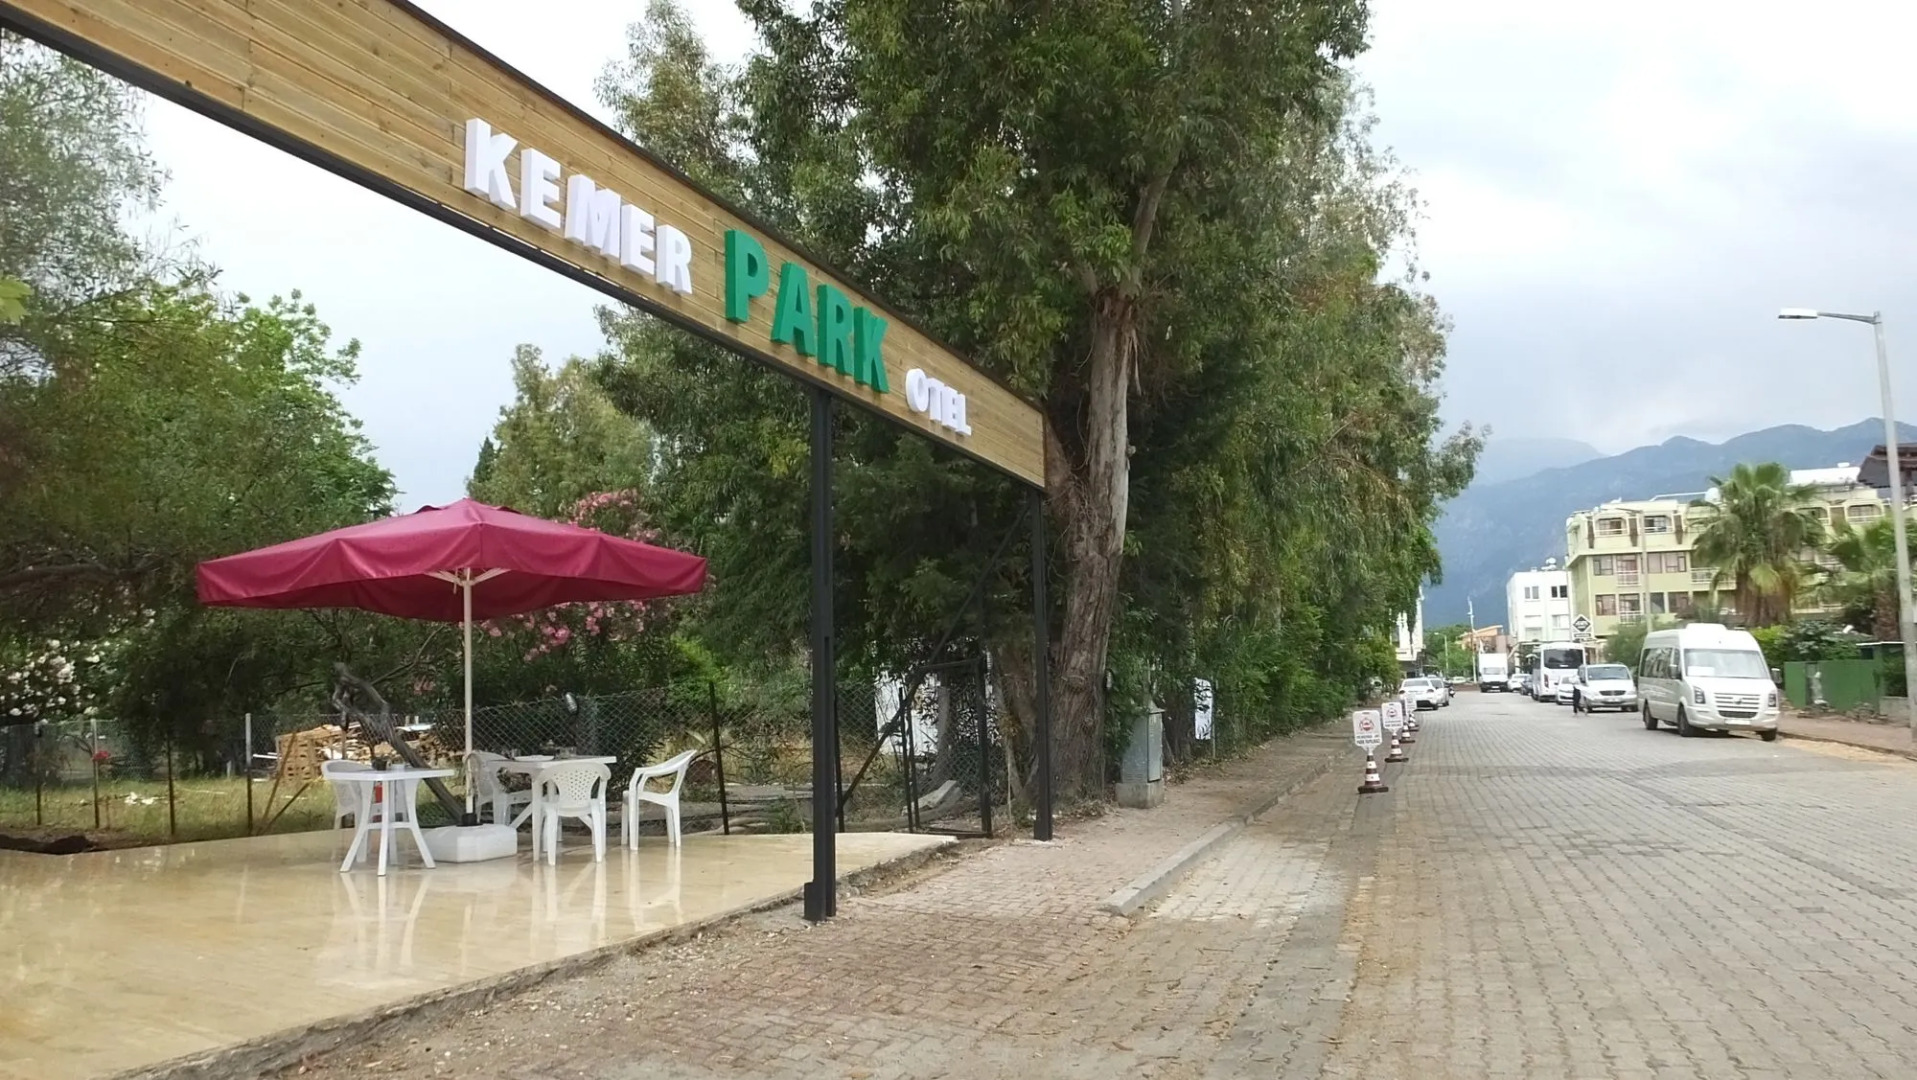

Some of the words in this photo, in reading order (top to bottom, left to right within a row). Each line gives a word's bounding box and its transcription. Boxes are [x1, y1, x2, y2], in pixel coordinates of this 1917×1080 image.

[464, 117, 693, 294] KEMER
[724, 229, 890, 394] PARK
[905, 368, 972, 436] OTEL
